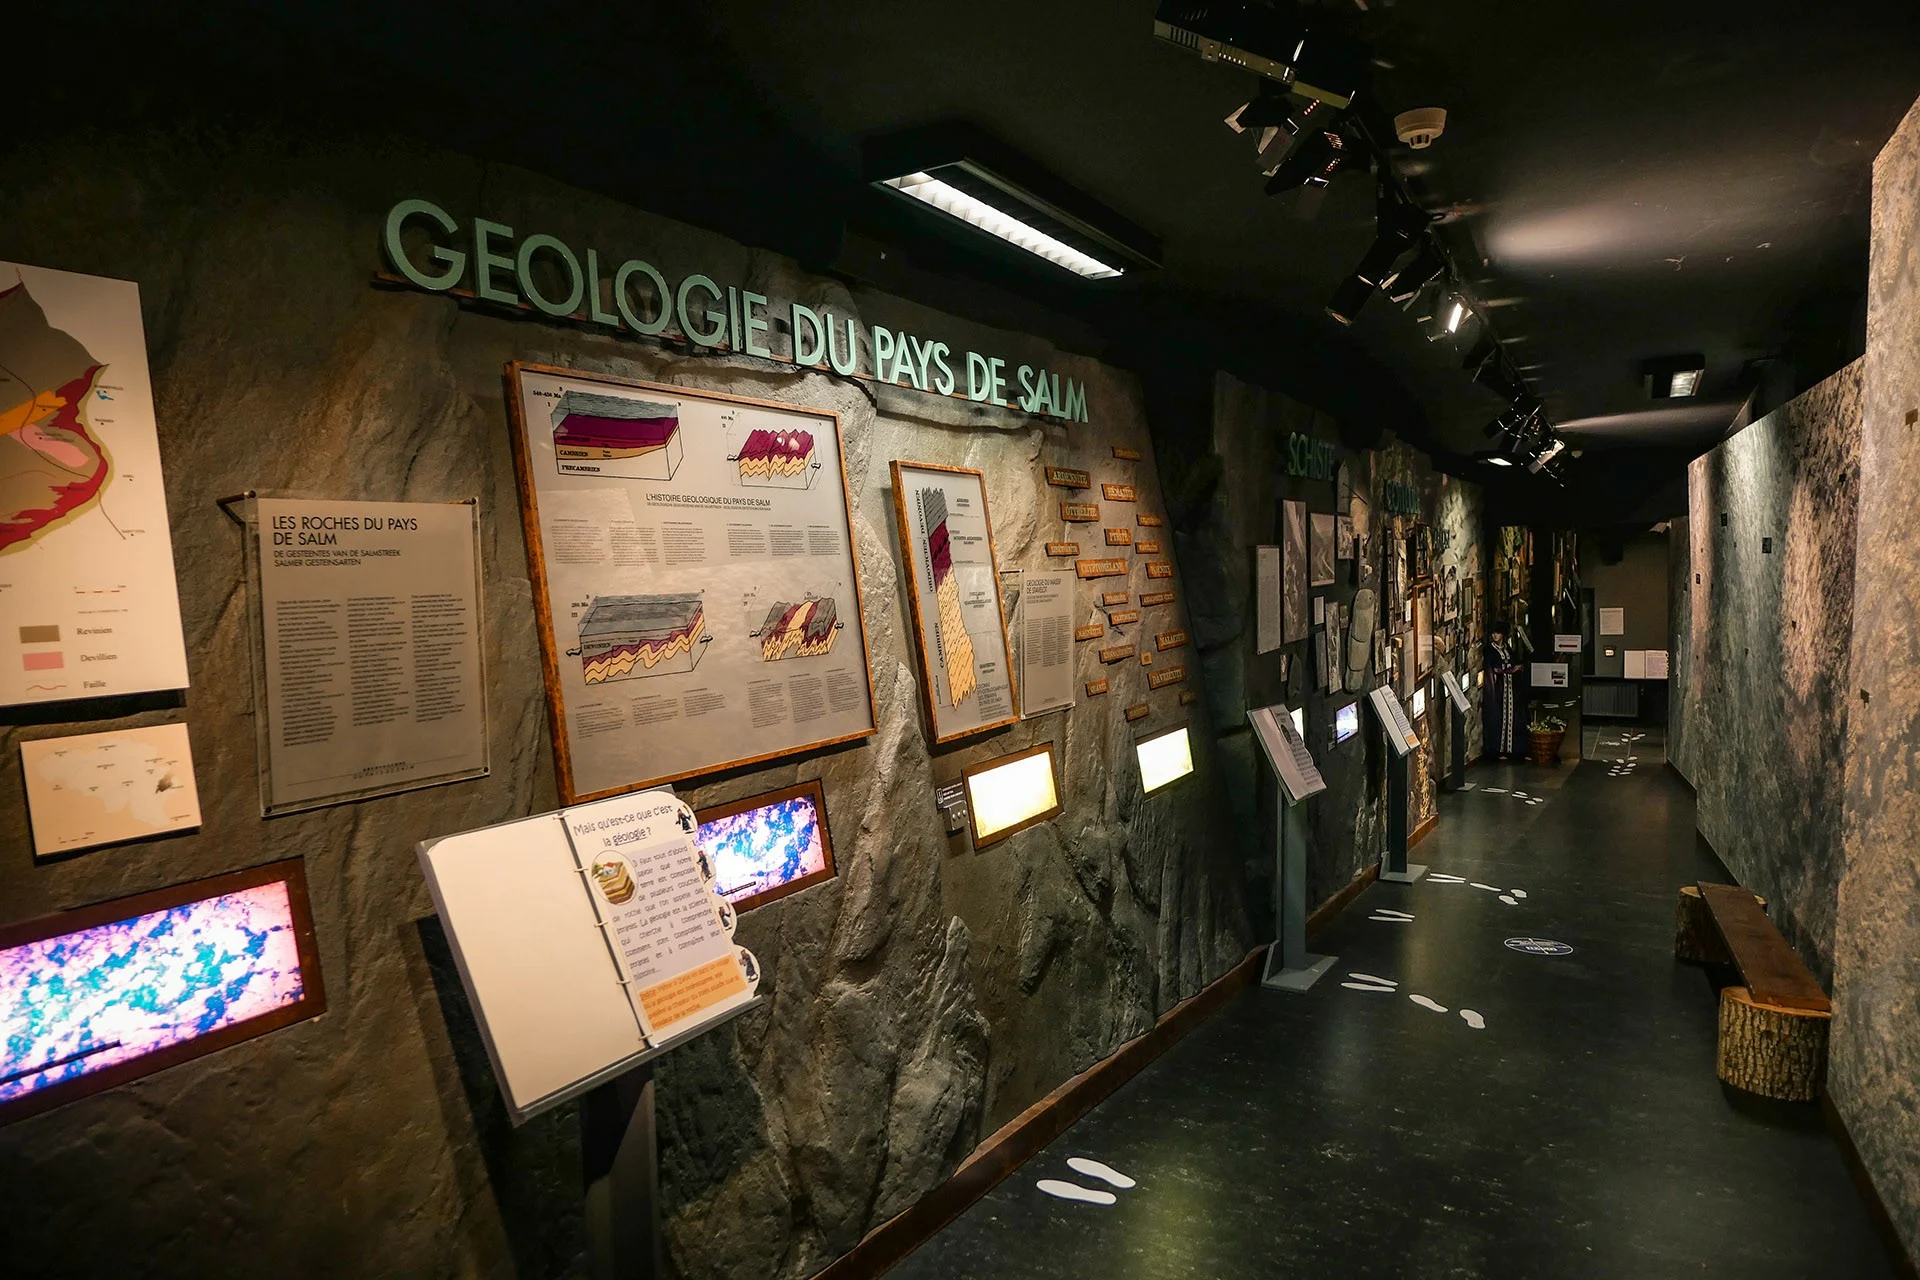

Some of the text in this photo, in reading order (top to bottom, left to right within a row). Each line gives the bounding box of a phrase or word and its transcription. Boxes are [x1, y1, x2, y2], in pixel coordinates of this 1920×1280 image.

[386, 199, 1089, 424] GEOLOGIE DU PAYS DE SALM
[1288, 431, 1336, 481] SCHISTE
[646, 493, 682, 503] L'HISTOIRE
[682, 494, 722, 505] GEOLOGIQUE
[723, 496, 732, 505] DU
[732, 497, 747, 506] PAYS
[747, 498, 755, 506] DE
[755, 499, 771, 507] SALM
[272, 516, 418, 531] LES ROCHES DU PAYS
[273, 532, 338, 546] DE SALM
[273, 550, 284, 558] DE
[76, 627, 113, 635] Revinien
[80, 653, 118, 662] Devillien
[83, 681, 107, 689] Faille
[573, 822, 596, 837] Mais
[636, 809, 652, 821] que
[602, 837, 612, 847] la
[612, 828, 647, 846] géologie
